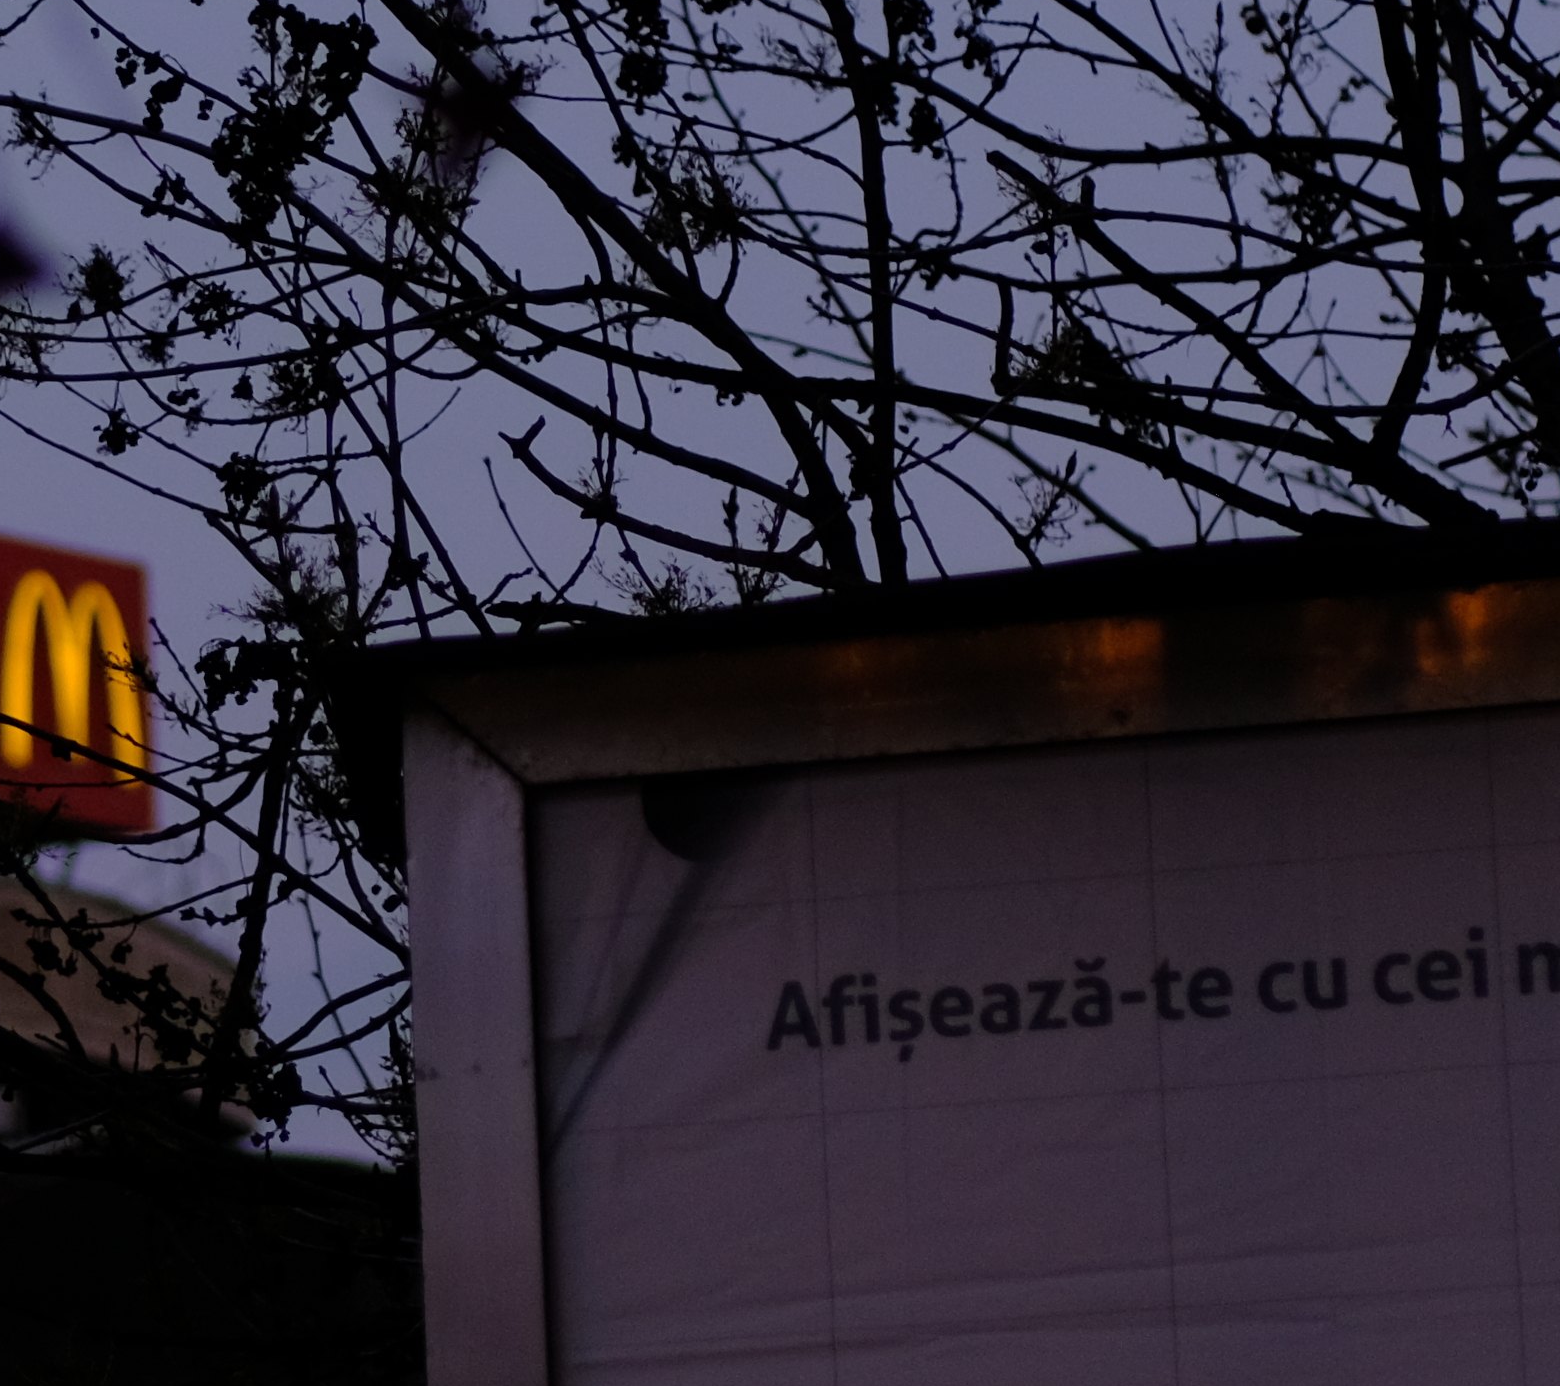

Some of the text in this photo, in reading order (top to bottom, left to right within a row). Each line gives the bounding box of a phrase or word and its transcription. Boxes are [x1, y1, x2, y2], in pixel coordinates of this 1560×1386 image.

[765, 955, 1234, 1063] Afișează-te
[1256, 956, 1349, 1014] cu
[1372, 925, 1491, 1006] cei
